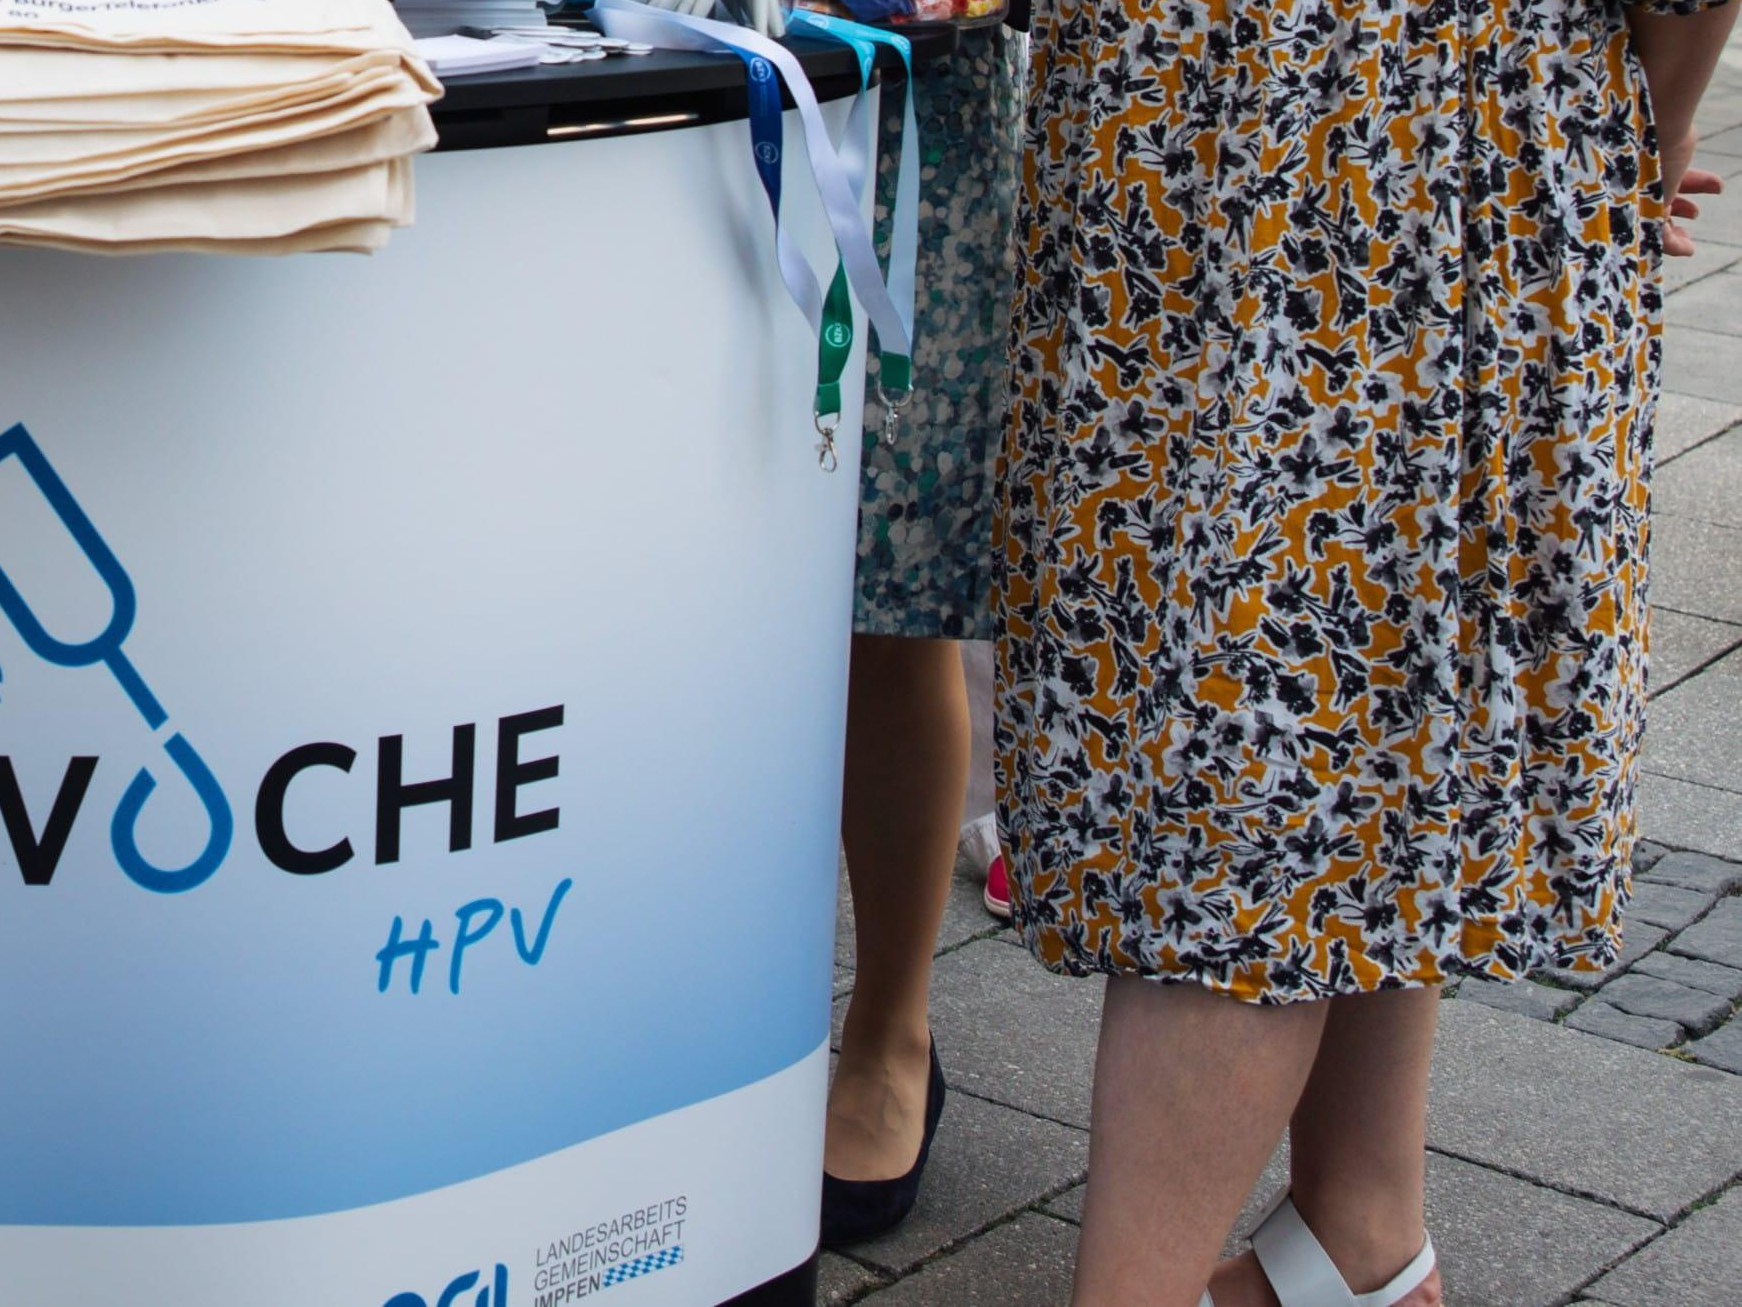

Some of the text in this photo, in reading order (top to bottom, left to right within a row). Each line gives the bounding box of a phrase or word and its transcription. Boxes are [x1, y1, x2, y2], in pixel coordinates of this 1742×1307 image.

[375, 877, 573, 996] HPV
[534, 1220, 686, 1291] GEMEINSCHAFT
[536, 1195, 688, 1267] LANDESARBEITS
